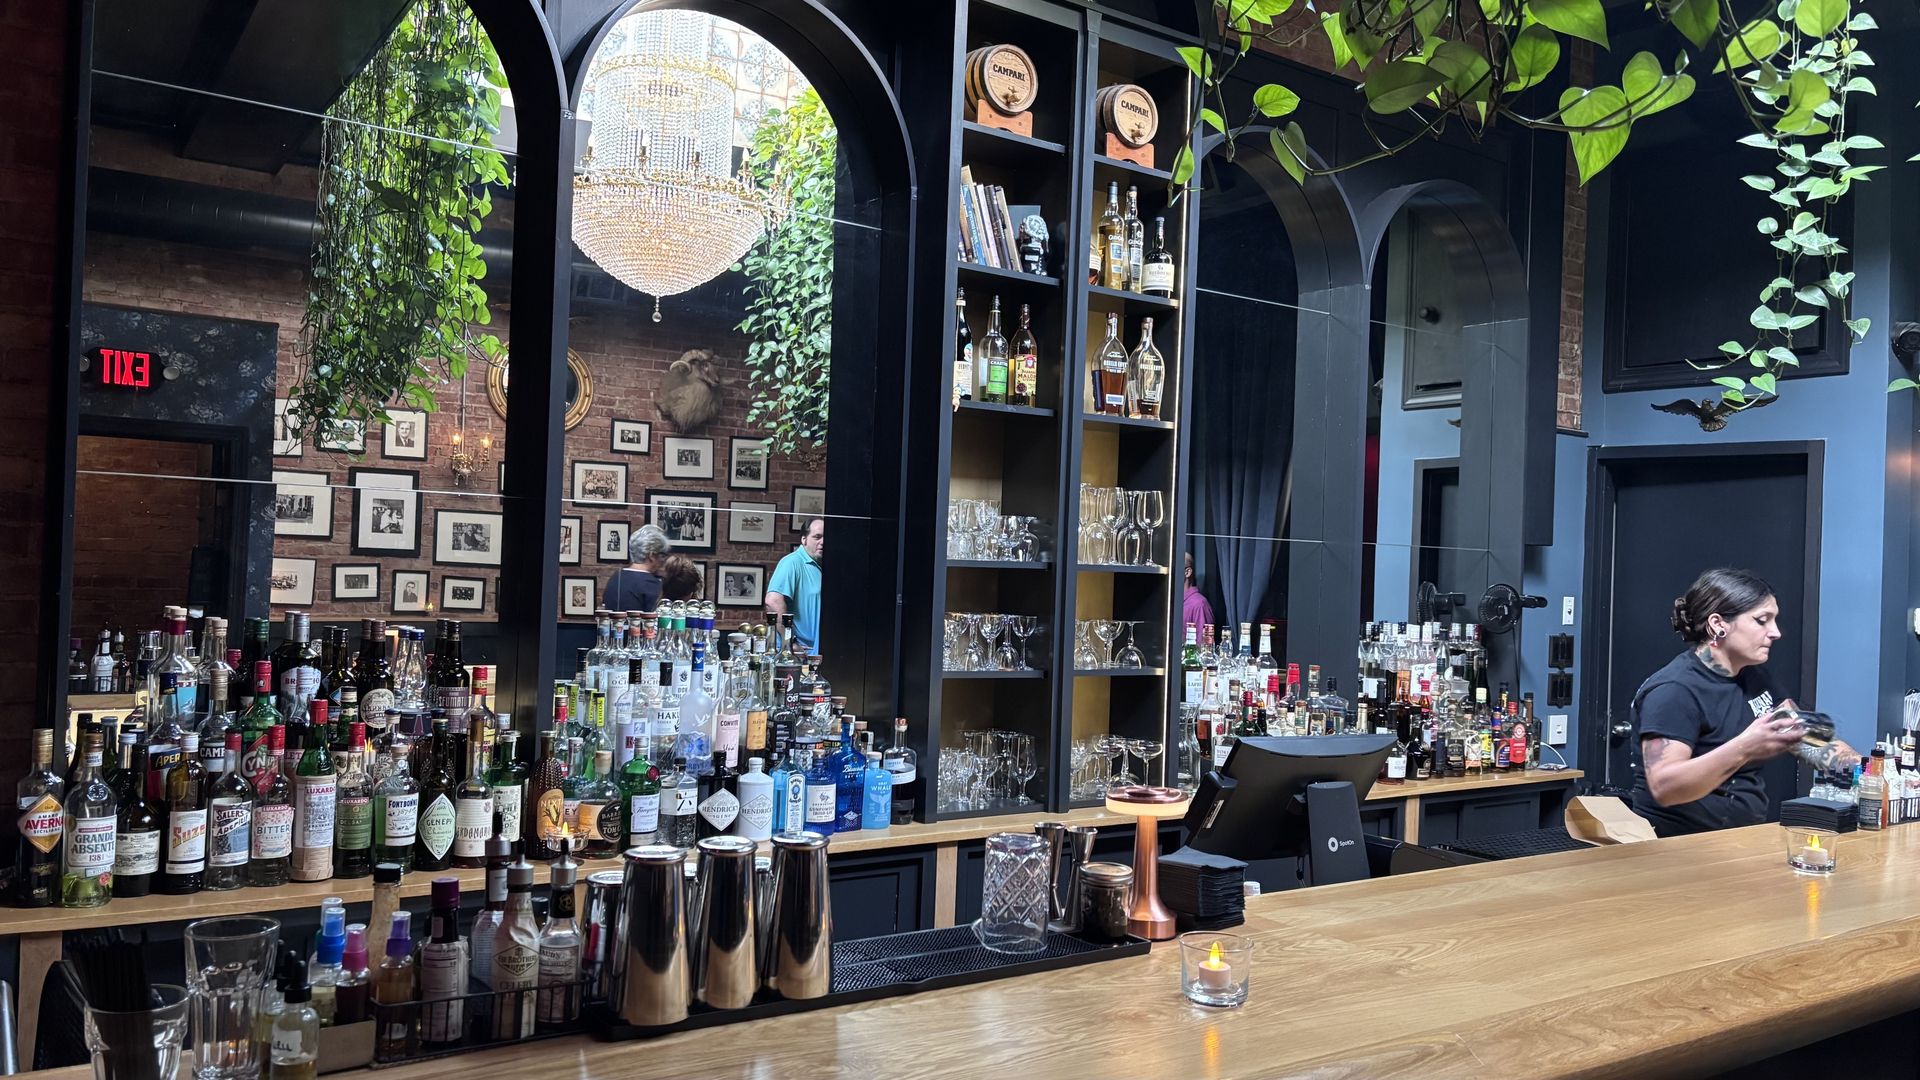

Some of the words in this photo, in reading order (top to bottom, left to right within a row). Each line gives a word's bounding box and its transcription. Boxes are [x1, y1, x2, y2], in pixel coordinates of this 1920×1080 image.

[992, 64, 1026, 82] CAMPARI
[1120, 100, 1150, 118] CAMPARI
[199, 748, 225, 759] CAMP
[155, 753, 181, 768] APER
[217, 808, 245, 820] SALERS
[701, 804, 739, 814] HENDRICK
[172, 823, 206, 849] Suze
[256, 824, 290, 835] BITTER
[74, 831, 114, 844] GRANDE
